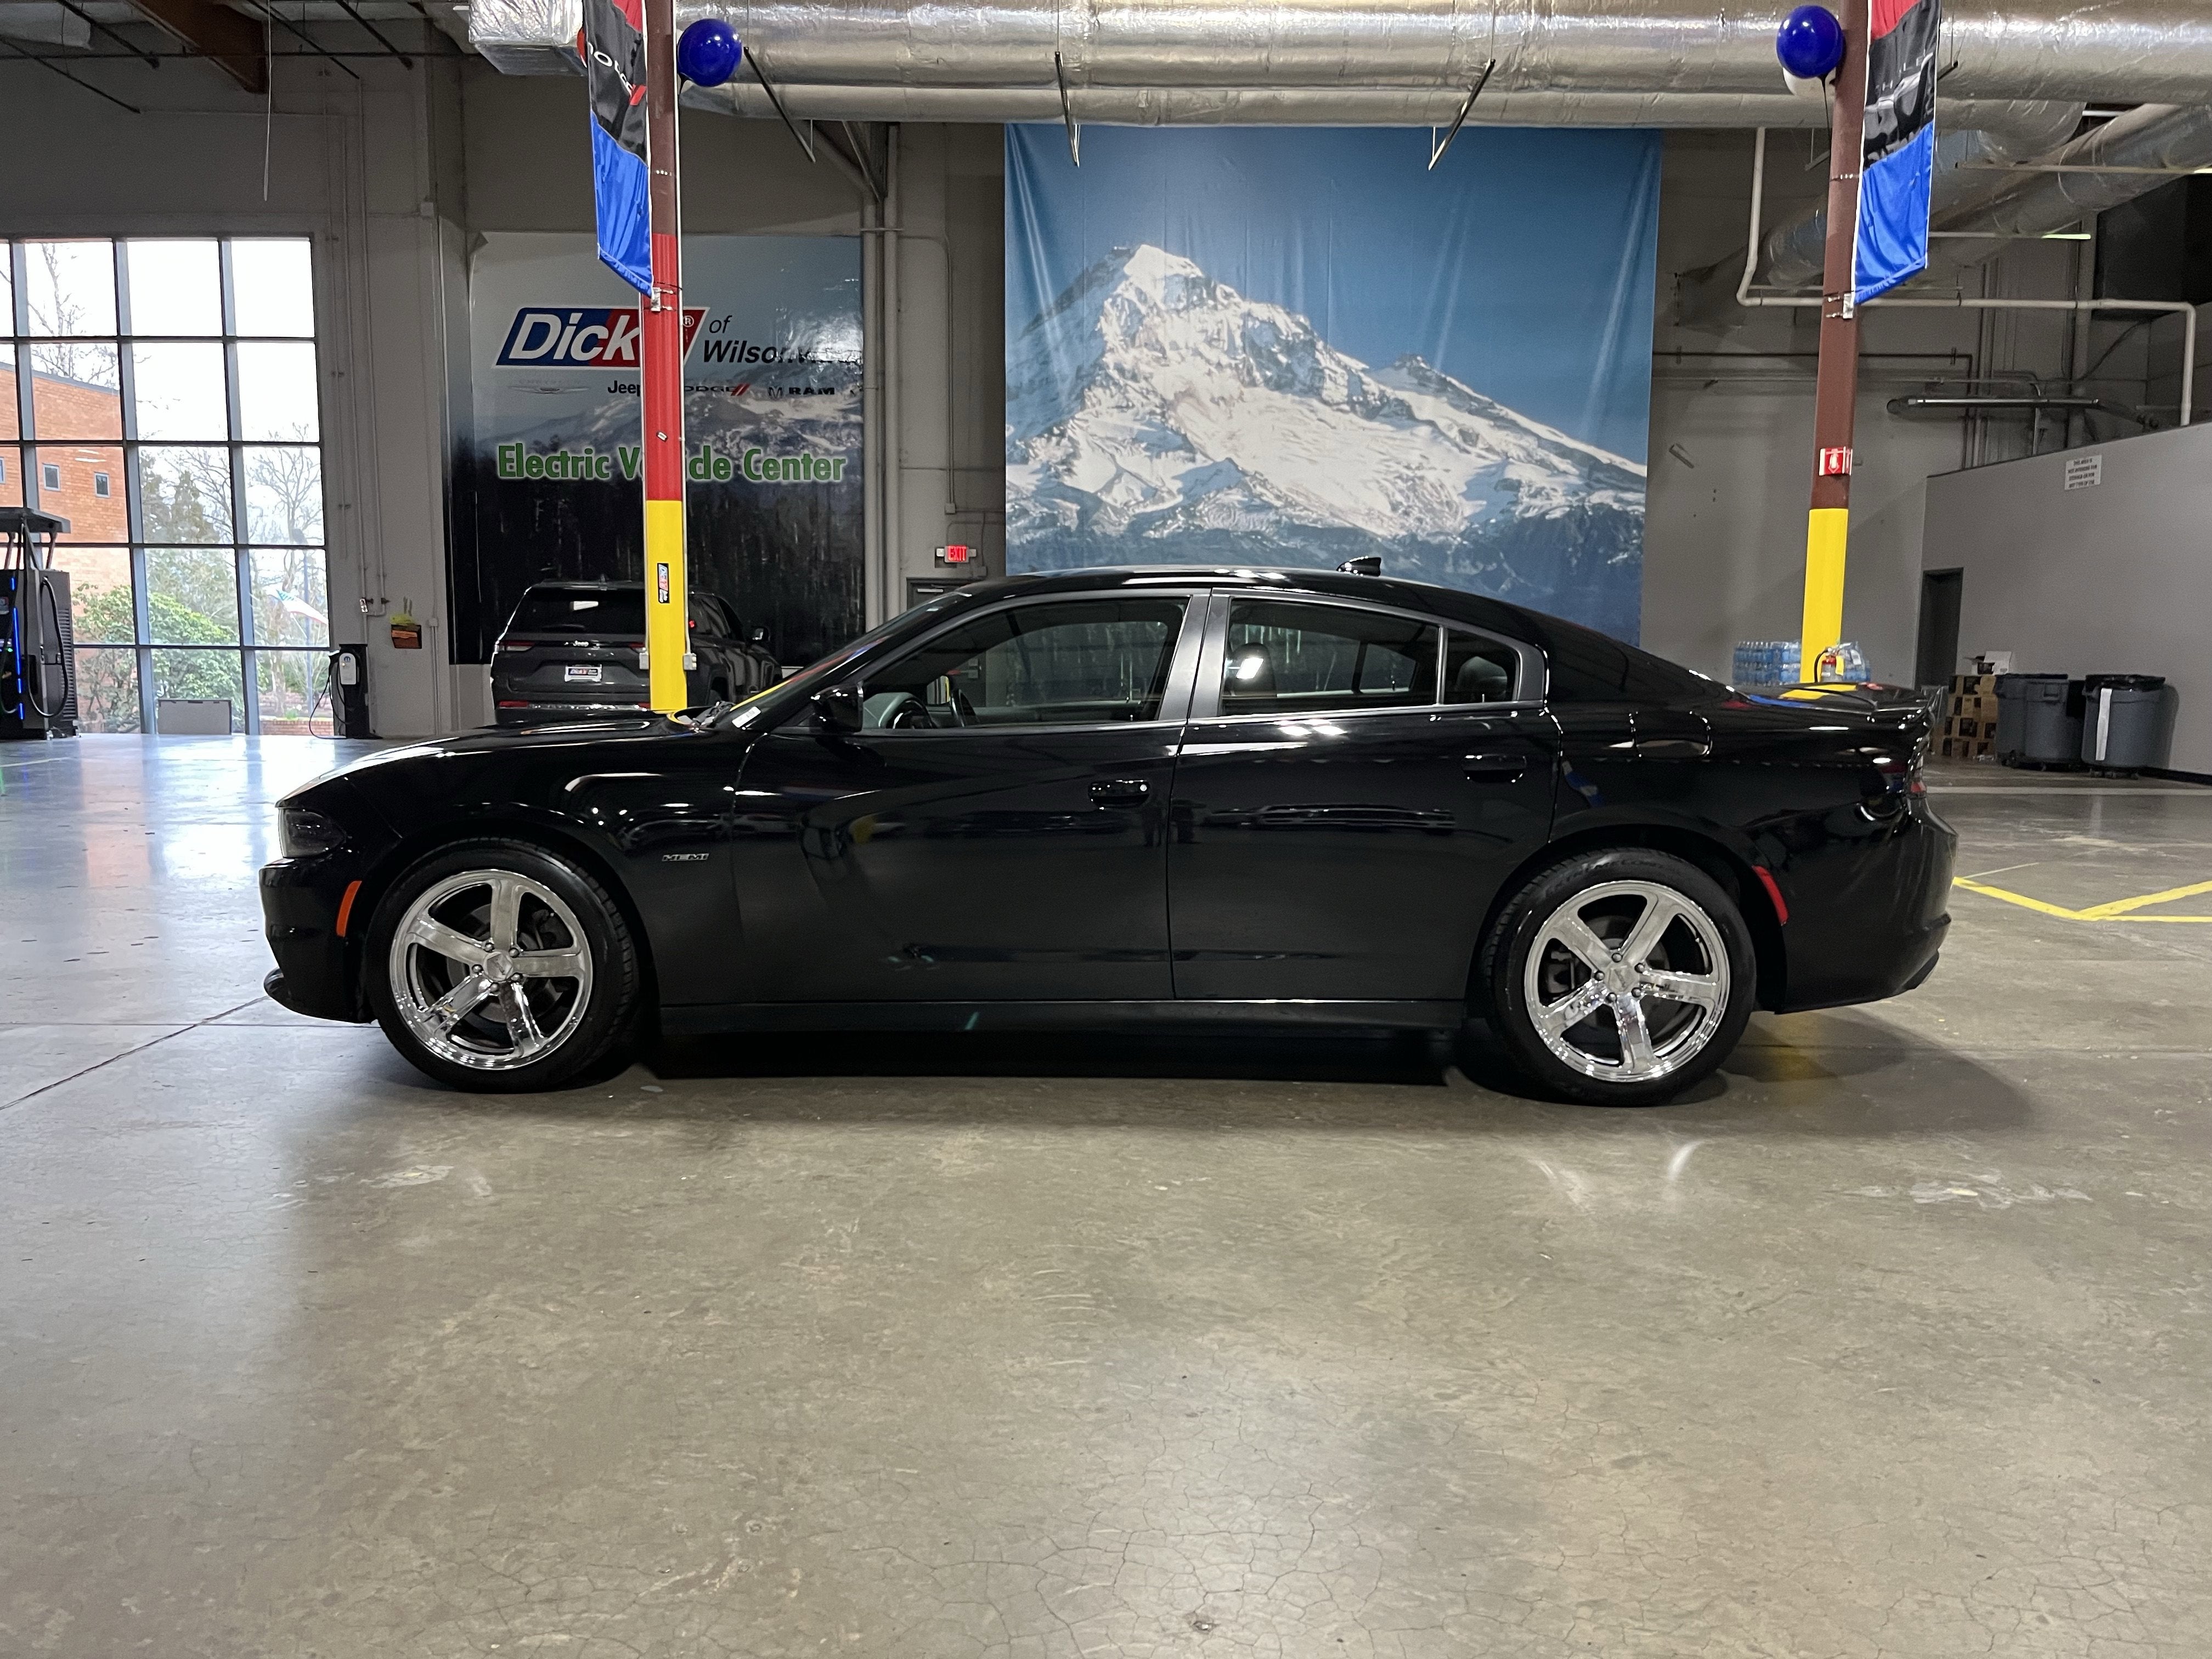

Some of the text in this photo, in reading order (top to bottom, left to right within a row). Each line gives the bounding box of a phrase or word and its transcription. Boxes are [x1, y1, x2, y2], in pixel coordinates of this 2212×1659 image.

[509, 313, 732, 361] Dick of
[788, 387, 835, 395] RAM
[498, 443, 847, 481] Electric Vcle Center
[948, 545, 967, 561] EXIT
